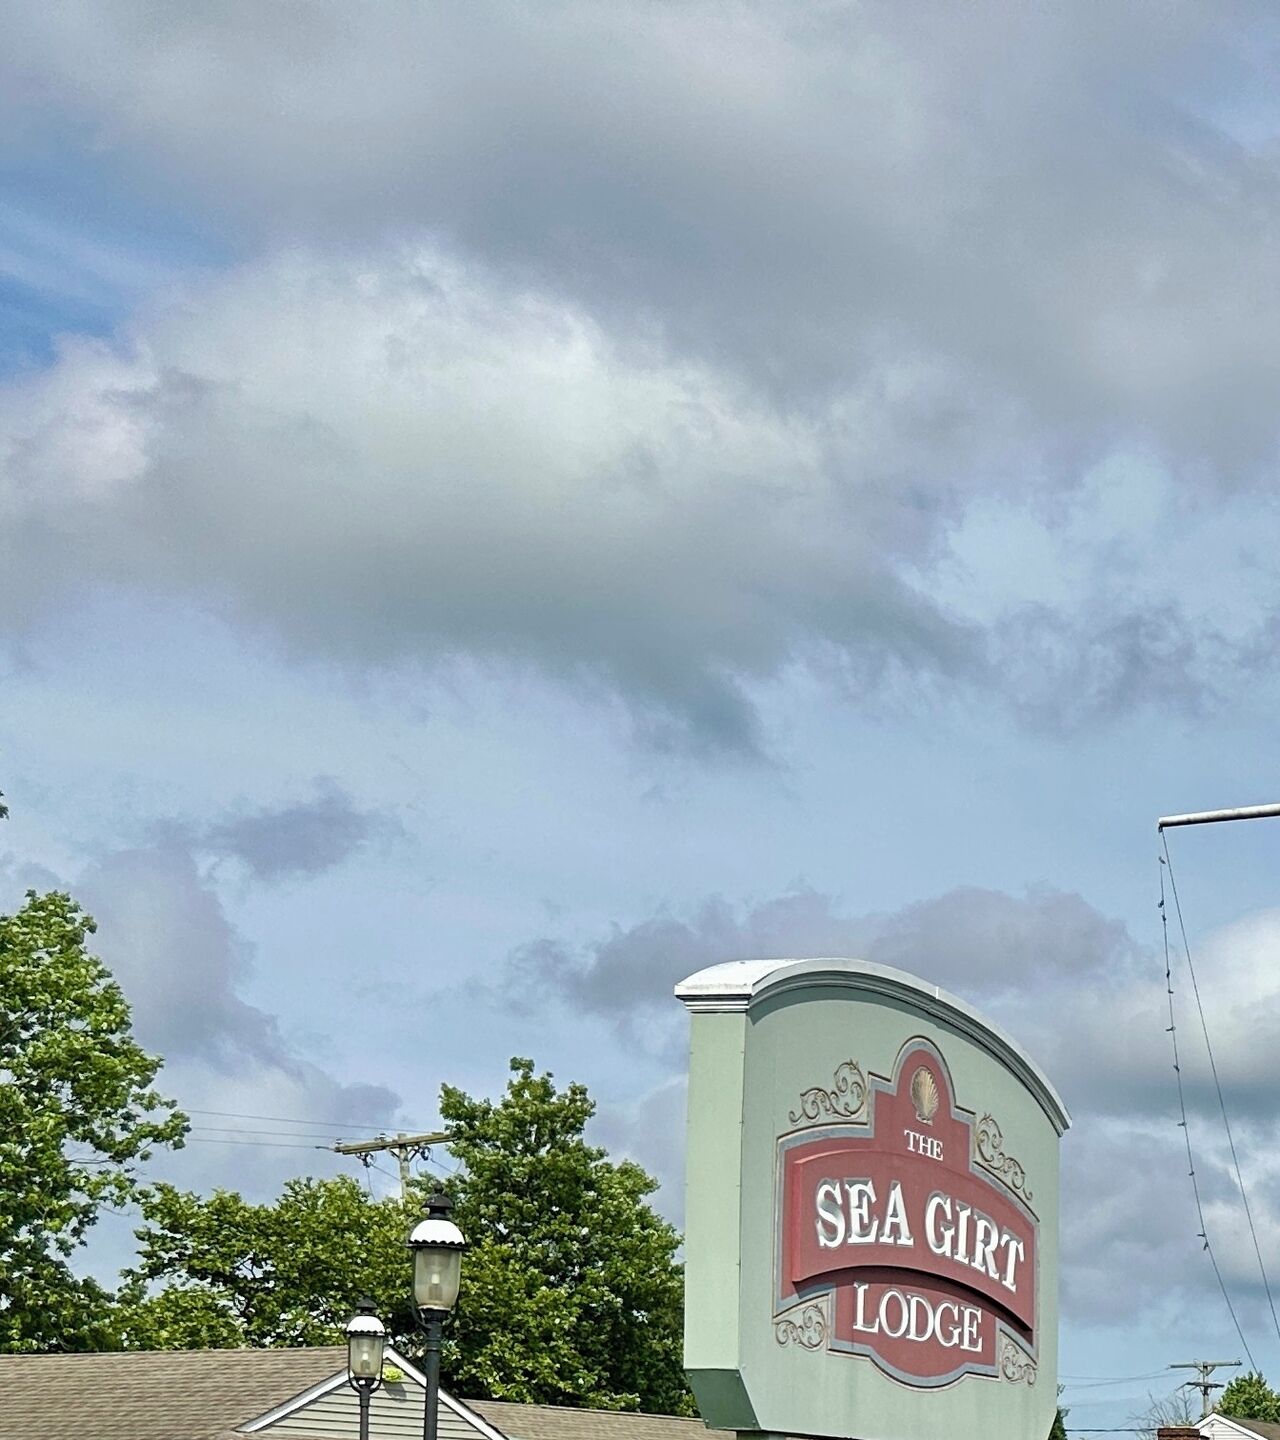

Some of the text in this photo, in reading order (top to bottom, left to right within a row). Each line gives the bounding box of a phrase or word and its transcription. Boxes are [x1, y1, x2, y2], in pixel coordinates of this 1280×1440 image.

[904, 1129, 944, 1162] THE
[815, 1177, 1025, 1294] SEA GIRT
[852, 1281, 984, 1353] LODGE
